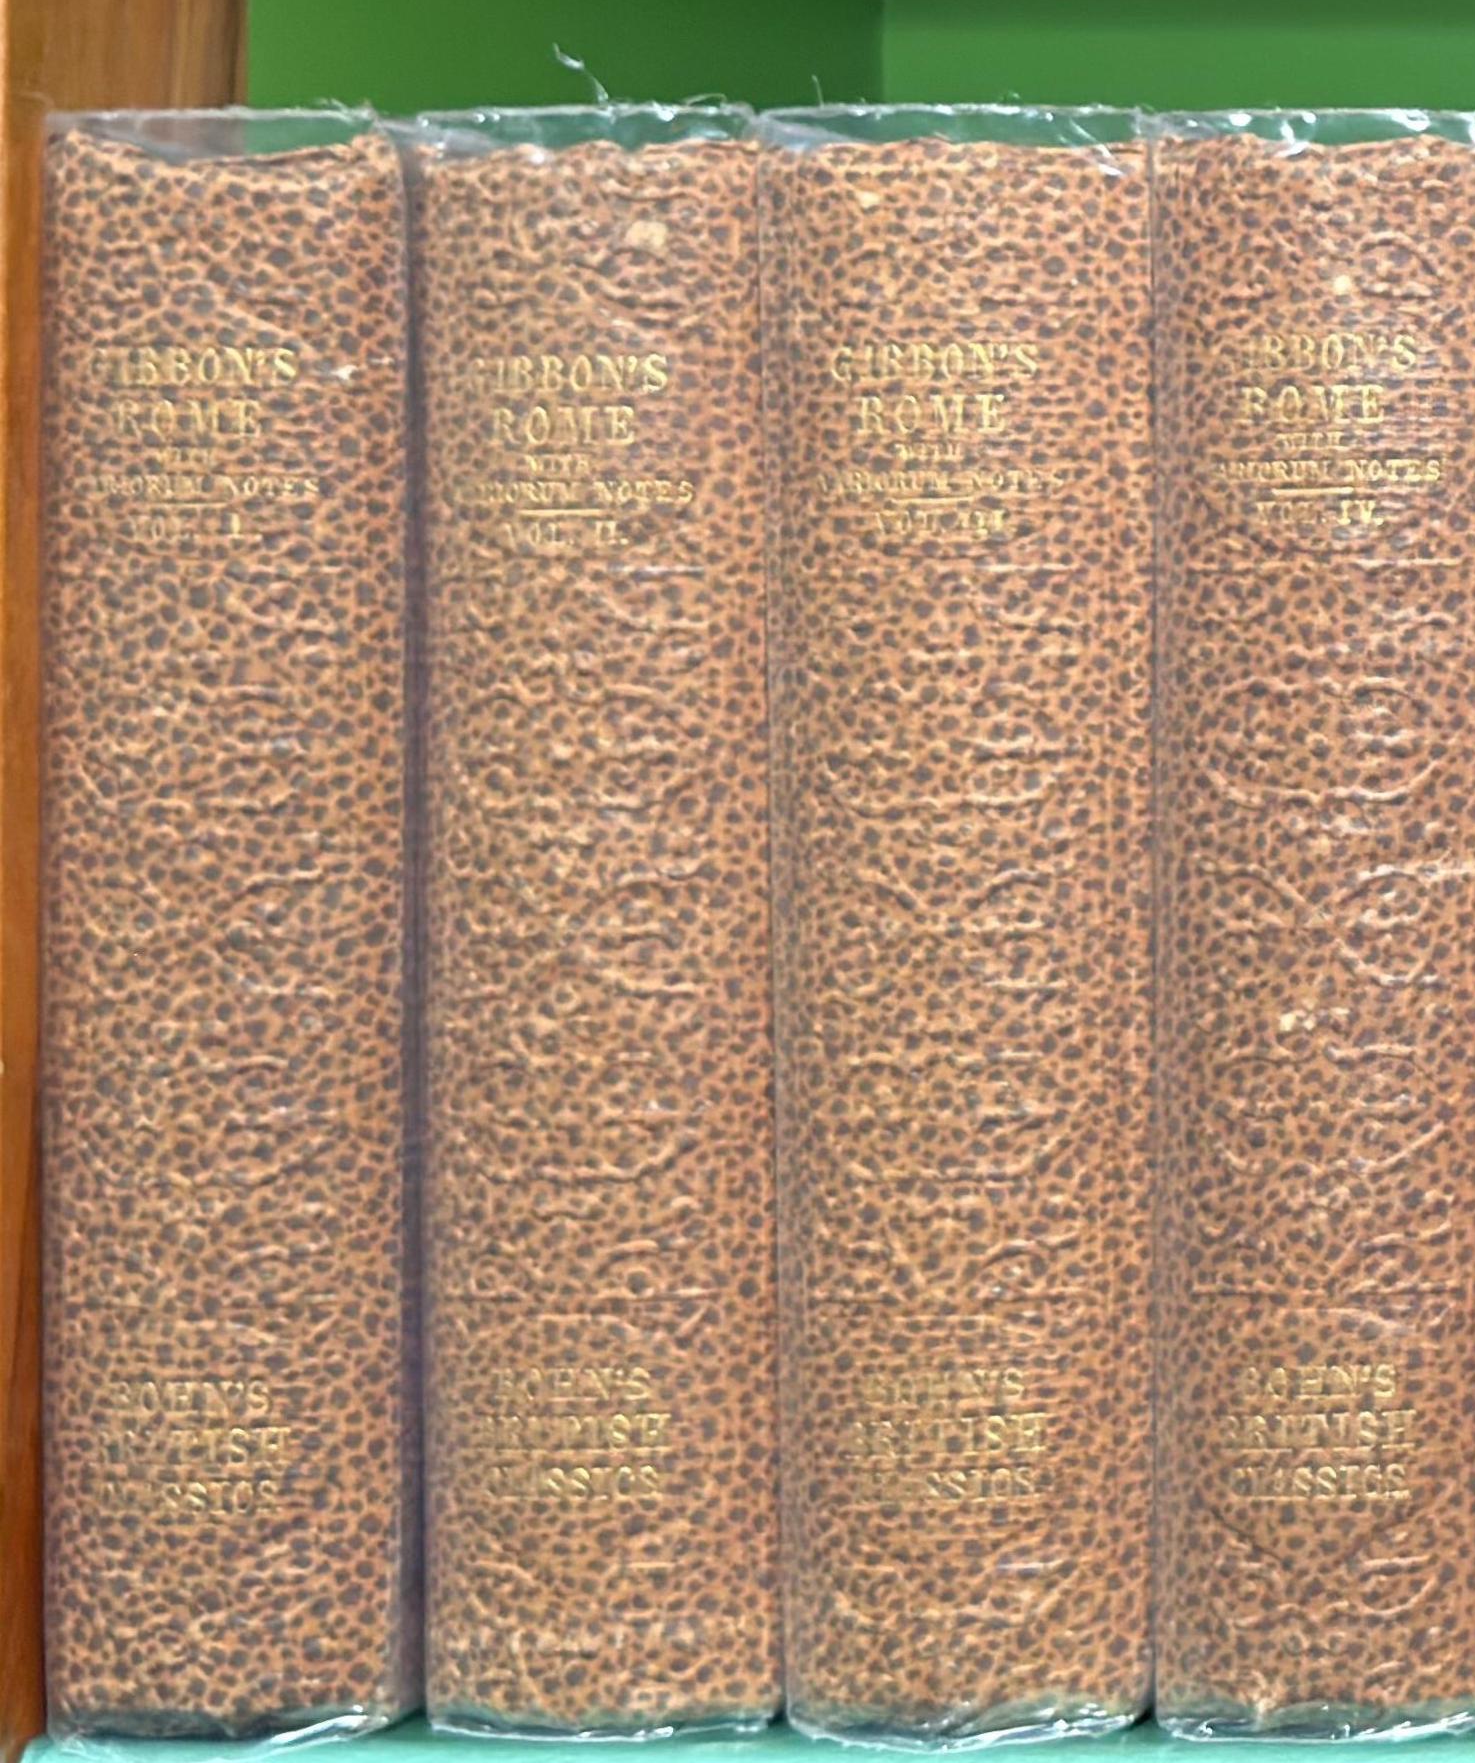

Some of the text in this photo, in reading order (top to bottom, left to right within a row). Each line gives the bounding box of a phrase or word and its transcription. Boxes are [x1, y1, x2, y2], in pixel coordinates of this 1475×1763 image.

[468, 353, 668, 392] GIBBON'S
[830, 342, 1039, 383] GIBBON'S
[117, 400, 261, 436] ROME
[856, 394, 1007, 434] ROME
[1240, 384, 1385, 425] ROME
[493, 405, 636, 445] ROME
[1207, 458, 1442, 483] ARIORUM NOTES
[594, 480, 695, 504] NOTES
[1340, 500, 1384, 526] IV.
